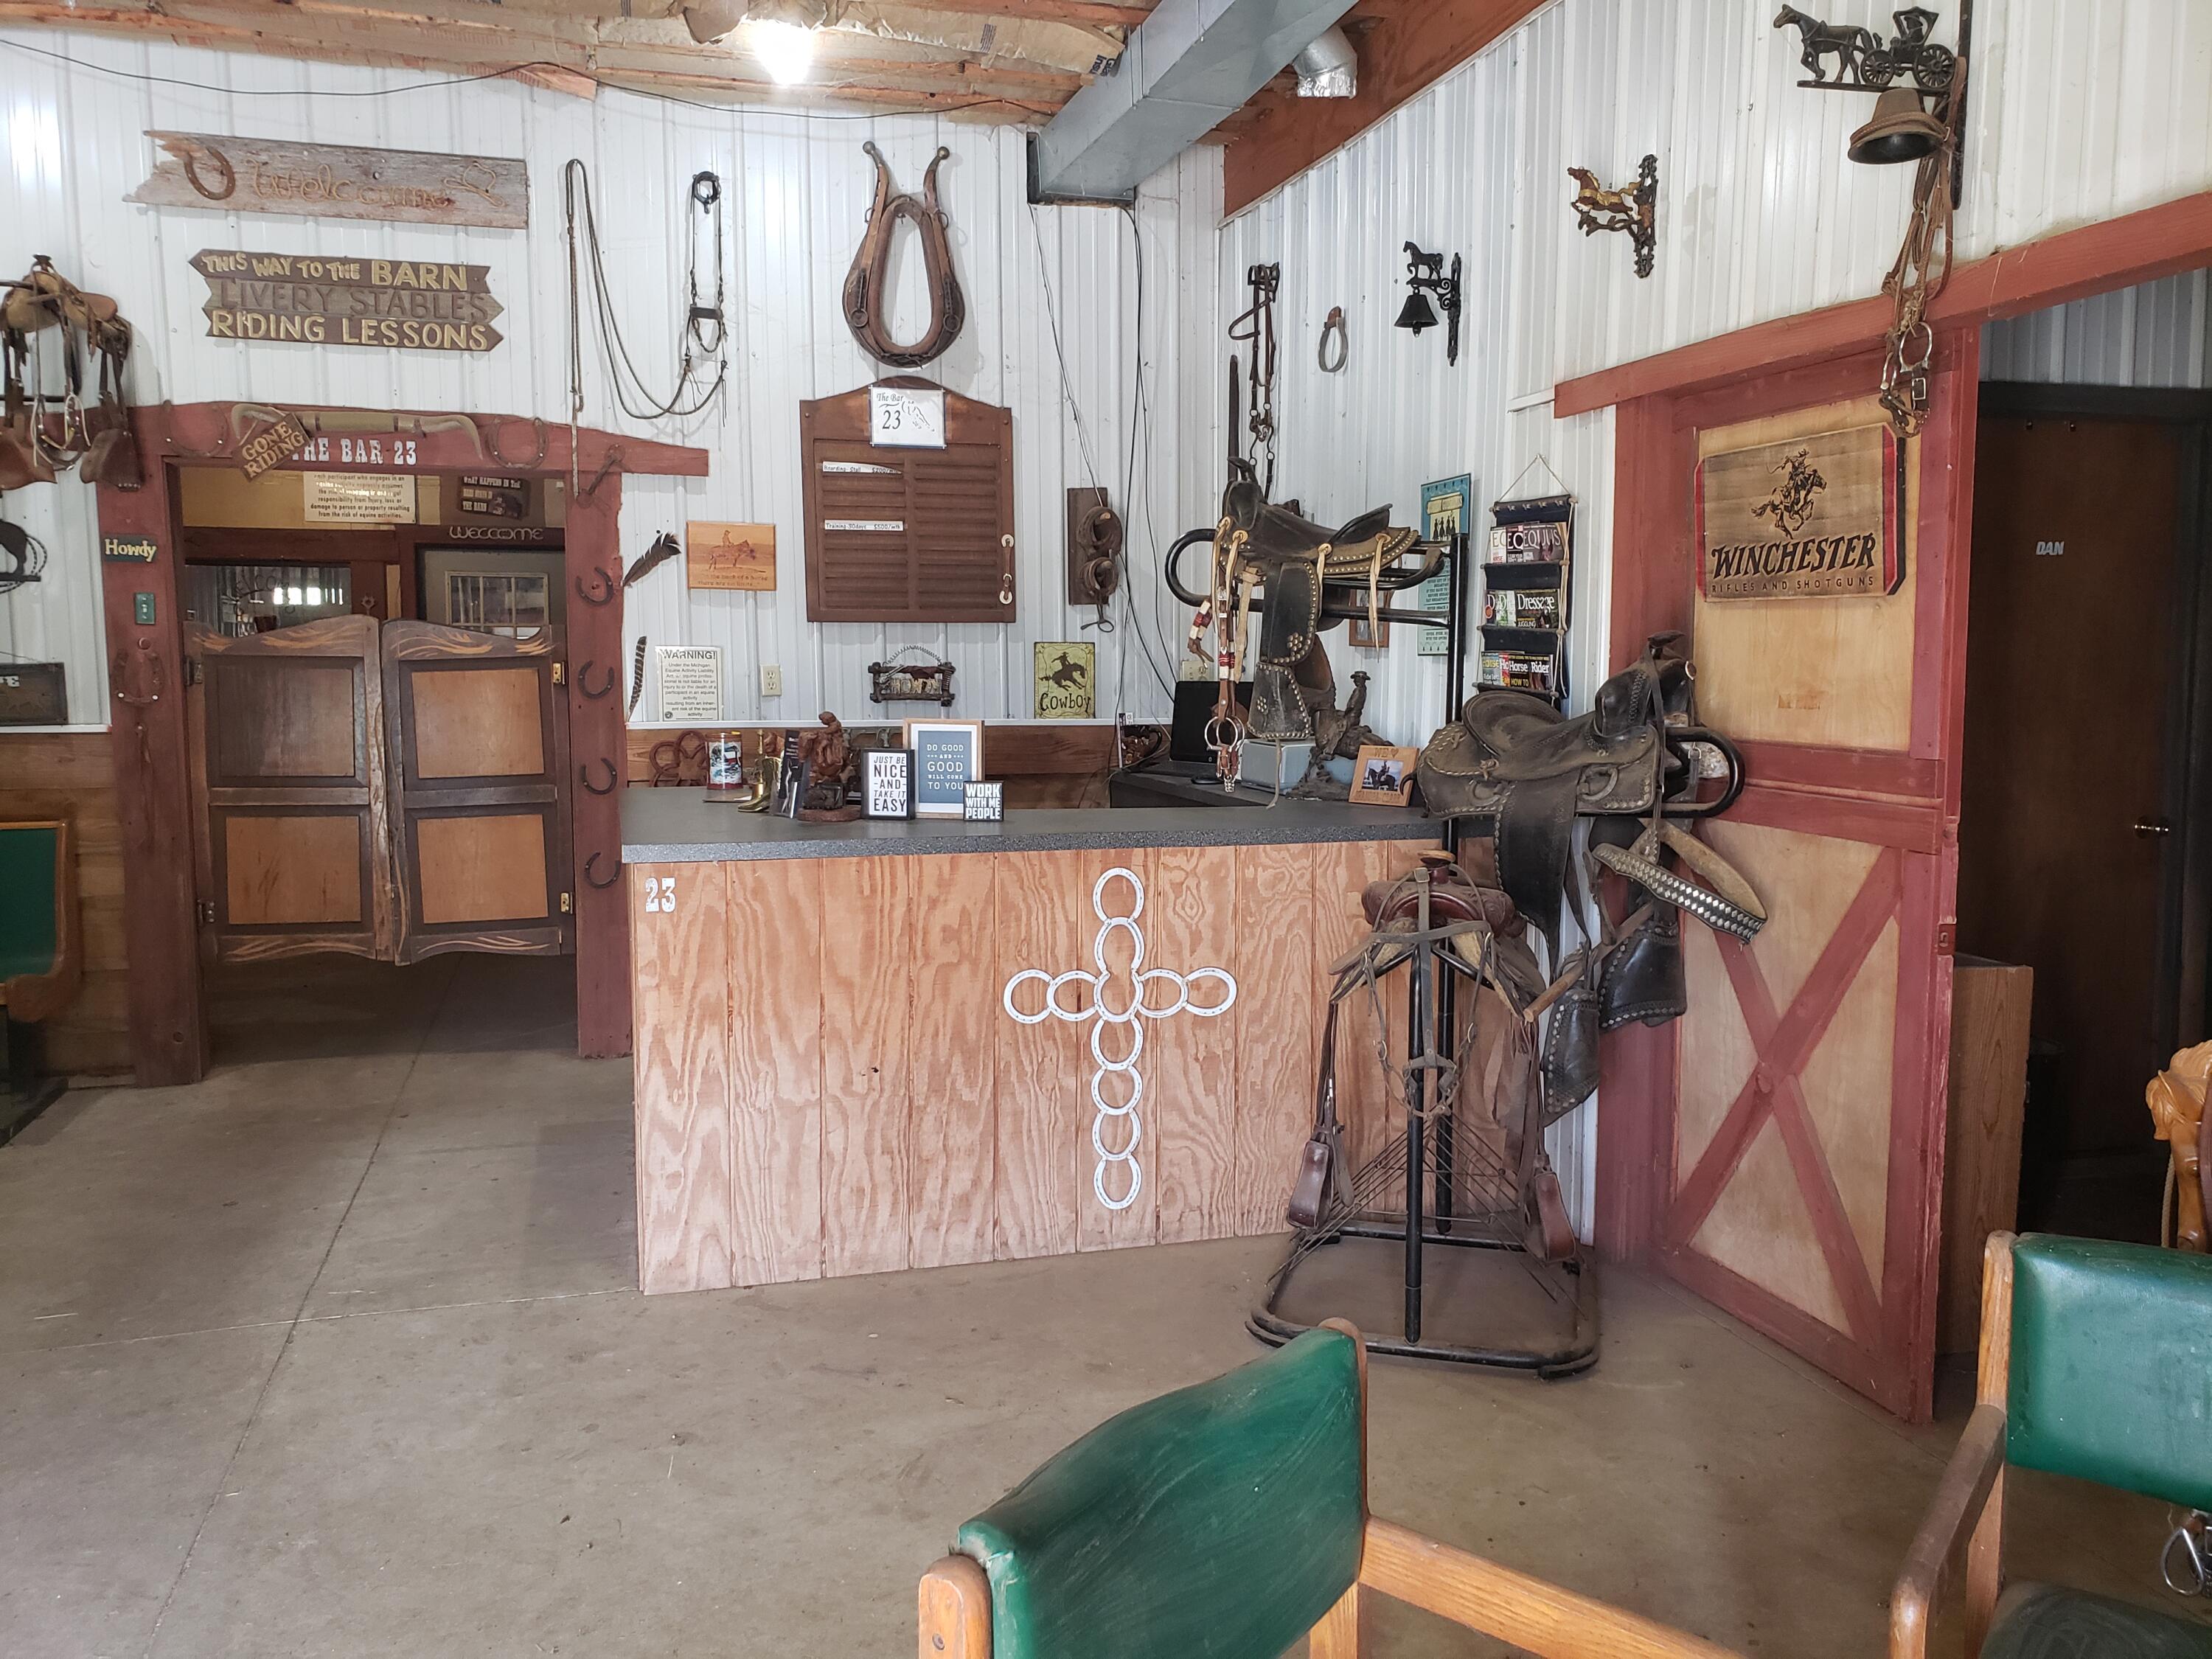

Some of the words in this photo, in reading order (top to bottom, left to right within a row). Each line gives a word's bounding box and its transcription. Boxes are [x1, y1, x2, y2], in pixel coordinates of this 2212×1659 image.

[244, 158, 450, 208] Welcome
[201, 251, 248, 273] THIS
[251, 257, 293, 277] WAY
[296, 260, 324, 278] TO
[326, 261, 361, 281] THE
[371, 260, 467, 291] BARN
[221, 279, 335, 312] LIVERY
[349, 286, 488, 321] STABLES
[212, 310, 325, 342] RIDING
[342, 318, 487, 350] LESSONS
[877, 392, 889, 402] The
[891, 394, 904, 402] Bar
[882, 410, 901, 429] 23
[242, 421, 292, 460] GONE
[244, 431, 305, 478] RIDING
[292, 437, 330, 462] HE
[341, 438, 383, 465] BAR
[394, 441, 417, 465] 23
[1523, 529, 1561, 549] EQUUS
[105, 539, 156, 562] Howdy
[1711, 532, 1876, 579] WINCHESTER
[2036, 541, 2065, 555] DAN
[1712, 582, 1755, 593] RIFLES
[1763, 581, 1787, 590] AND
[1797, 577, 1874, 589] SHOTGUNS
[1517, 594, 1555, 613] Dressage
[663, 649, 715, 659] WARNING!
[1509, 661, 1528, 672] Horse
[1531, 661, 1550, 672] Rider
[891, 678, 942, 694] HOWDY
[1040, 692, 1091, 712] Cowboy
[941, 744, 964, 752] GOOD
[874, 765, 907, 778] NICE
[928, 762, 963, 772] GOOD
[928, 782, 940, 790] TO
[945, 782, 963, 790] YOU
[966, 784, 1000, 798] WORK
[874, 799, 906, 813] EASY
[966, 798, 987, 807] WITH
[989, 798, 1000, 807] ME
[966, 808, 1000, 820] PEOPLE
[645, 877, 675, 913] 23
